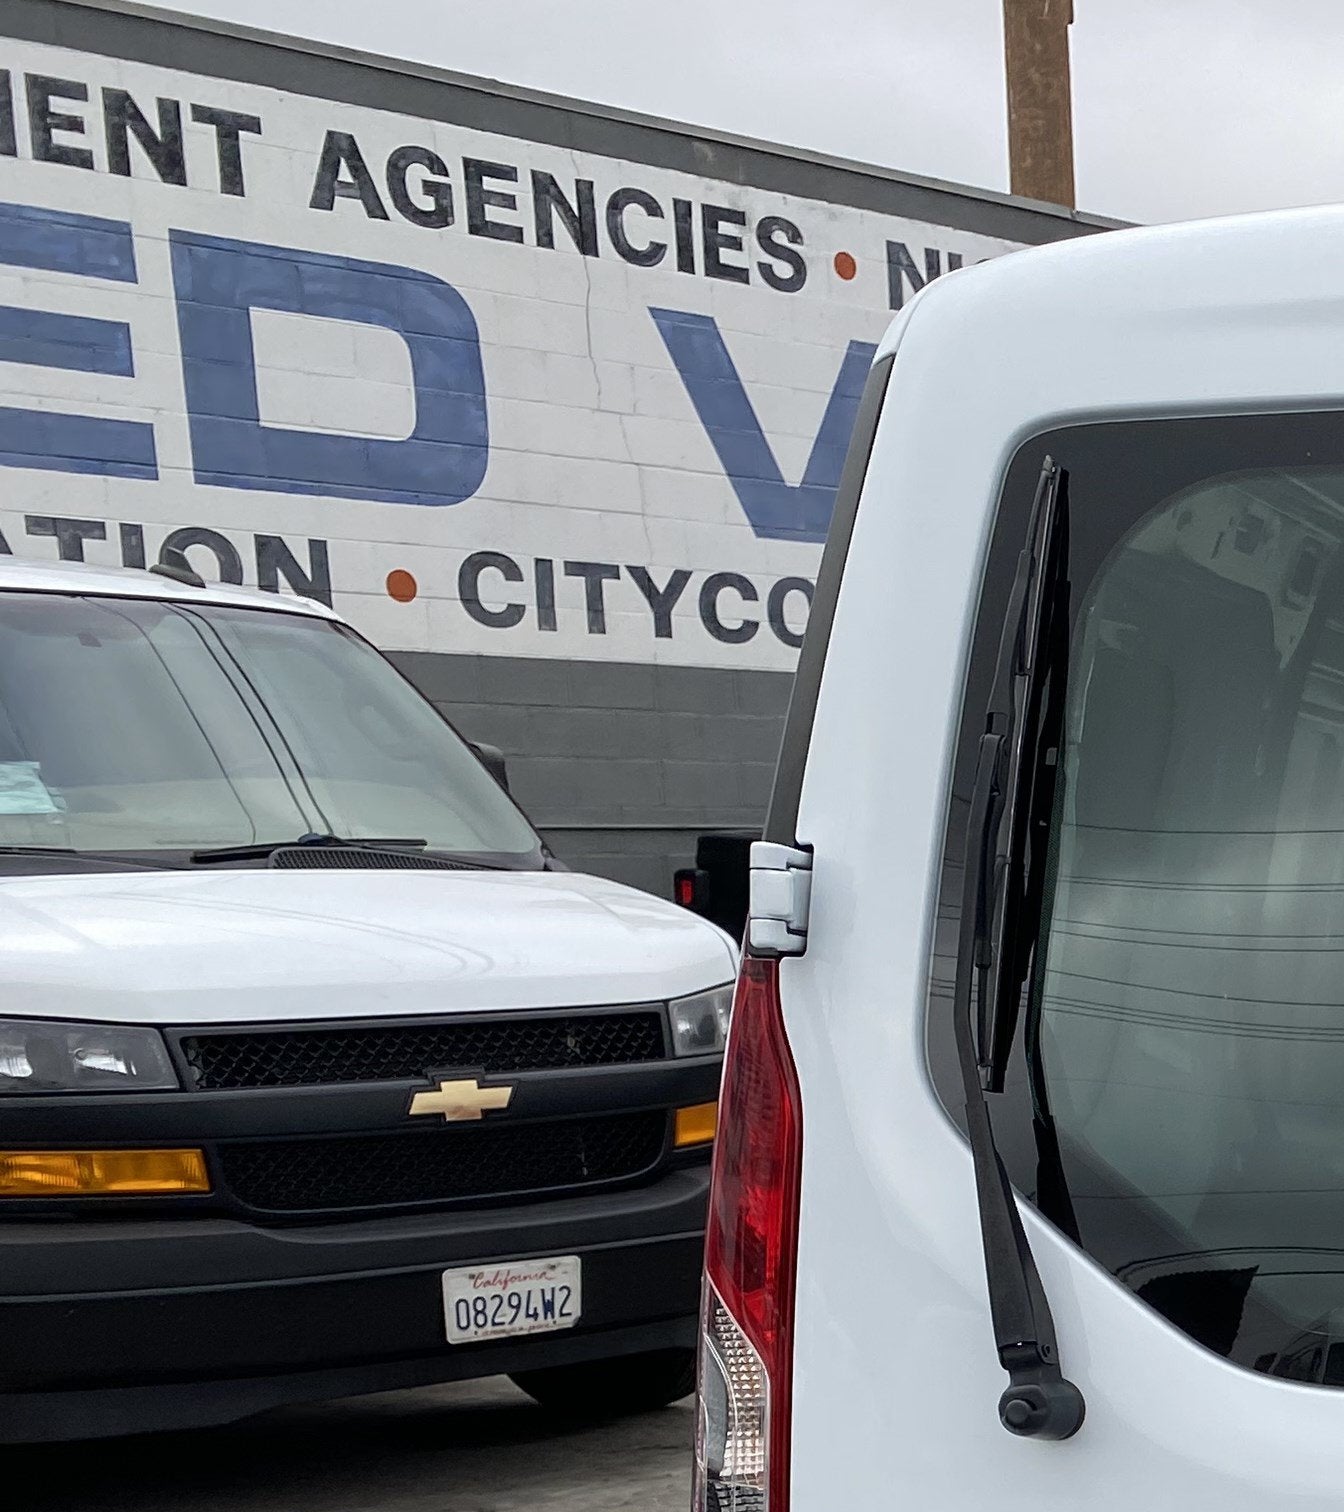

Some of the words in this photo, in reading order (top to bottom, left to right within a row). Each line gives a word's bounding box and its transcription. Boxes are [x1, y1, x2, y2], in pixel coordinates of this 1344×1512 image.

[0, 69, 262, 197] ENT
[309, 129, 807, 294] AGENCIES
[0, 514, 333, 610] TION
[458, 550, 817, 650] CITYCO
[455, 1285, 573, 1330] 08294W2
[473, 1270, 555, 1290] California
